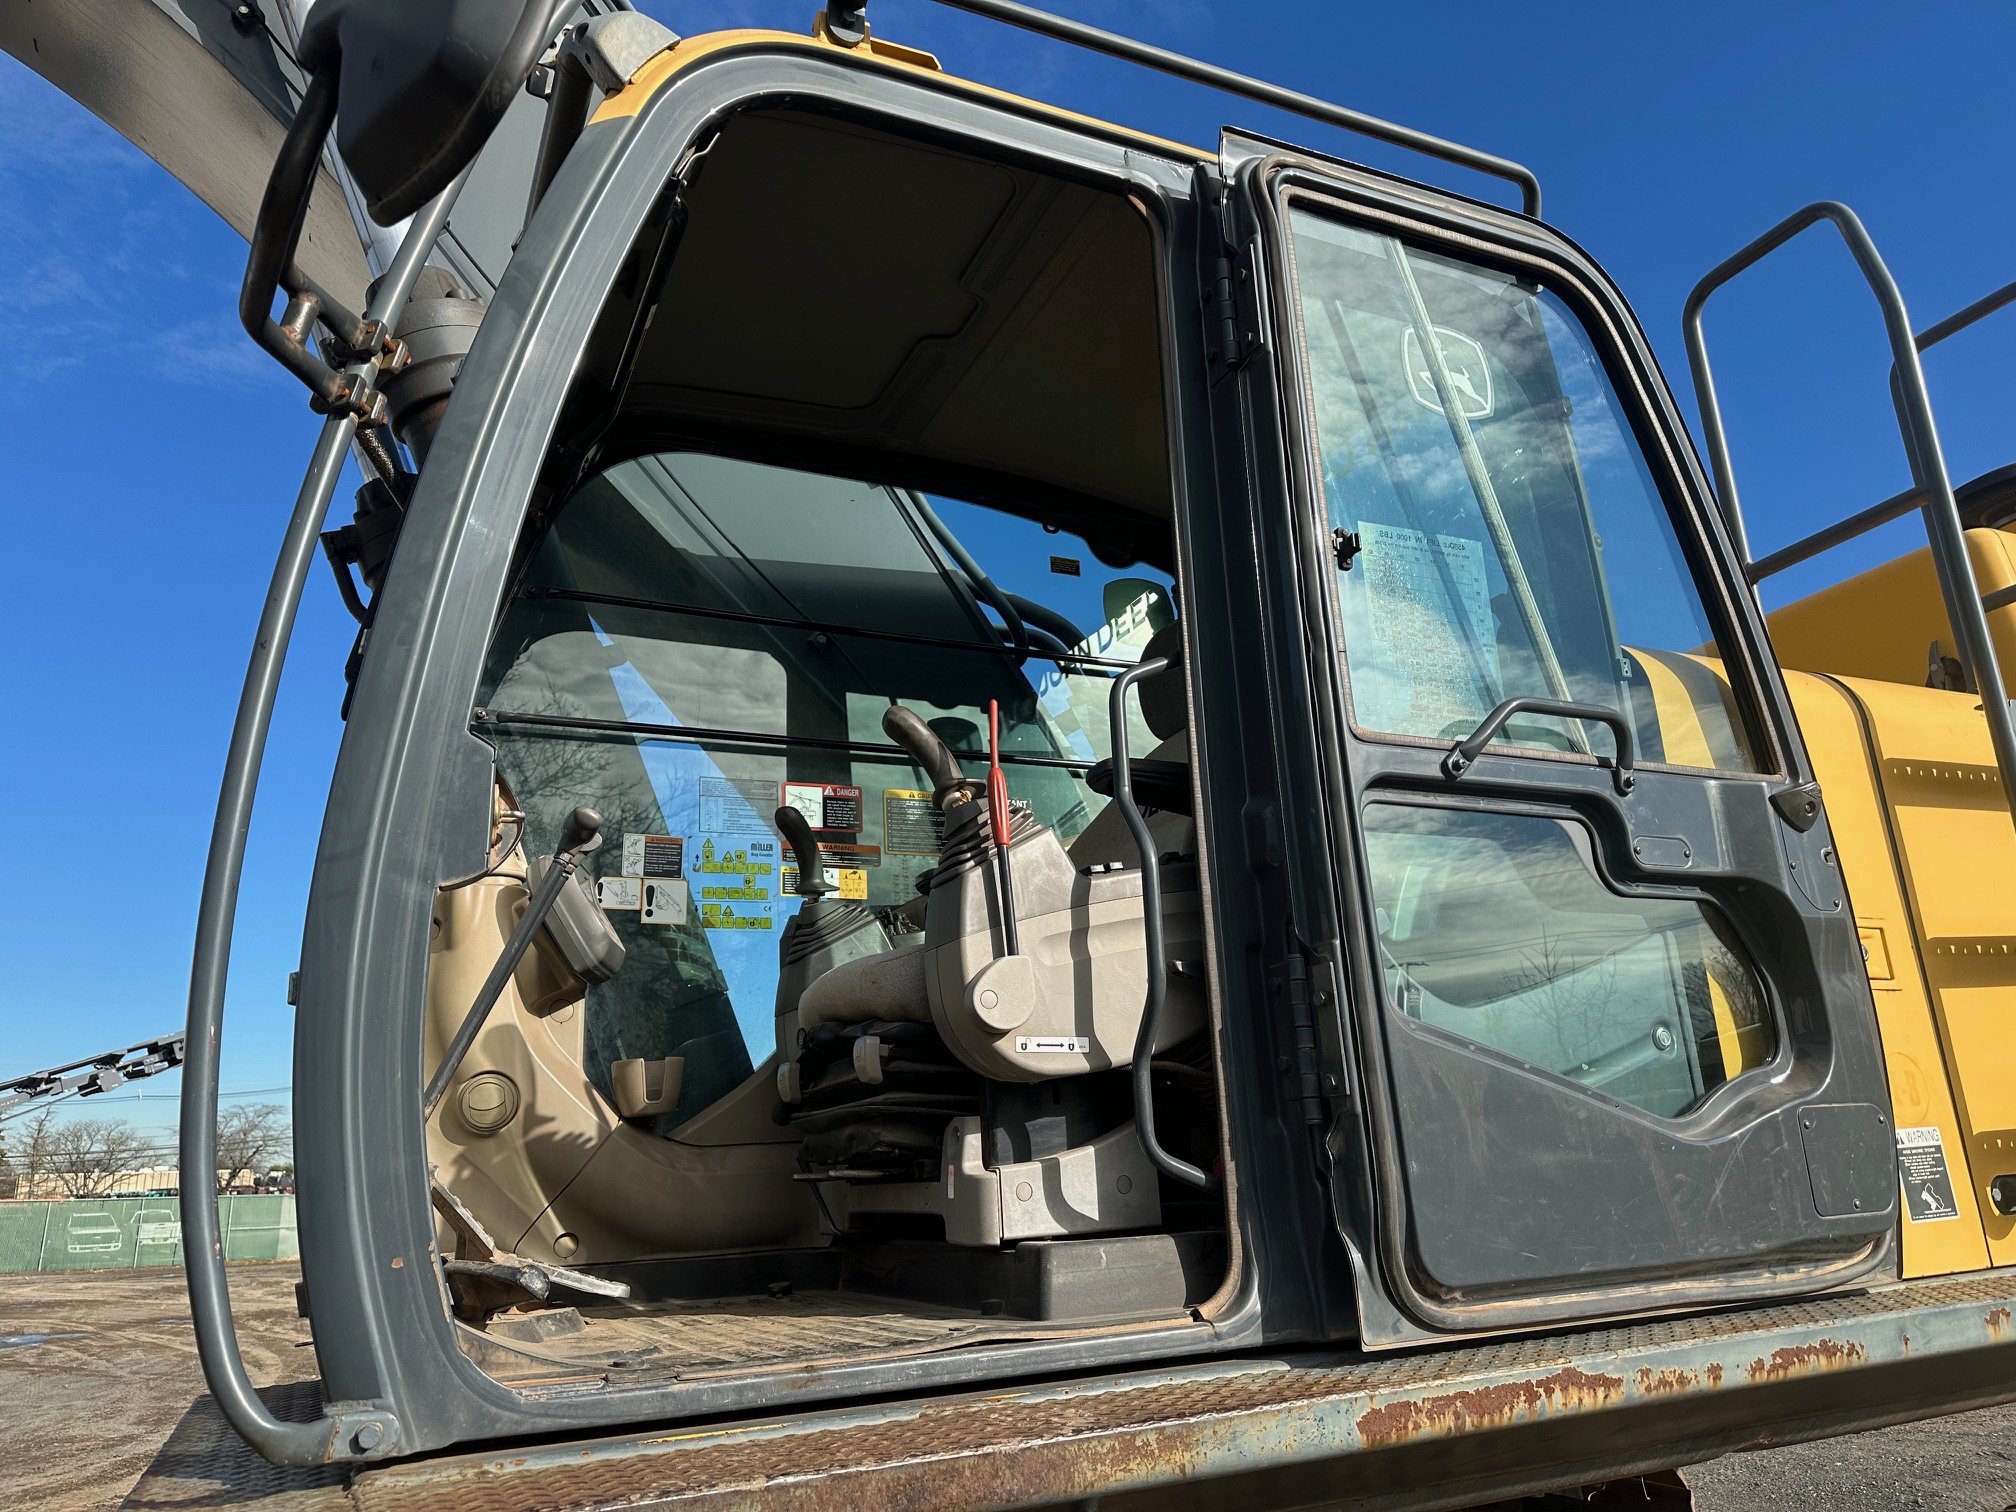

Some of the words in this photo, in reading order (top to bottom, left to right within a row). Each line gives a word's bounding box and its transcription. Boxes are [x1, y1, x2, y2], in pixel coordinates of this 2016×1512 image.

[836, 787, 859, 797] DANGER
[821, 844, 855, 852] WARNING
[1905, 1128, 1940, 1144] WARNING
